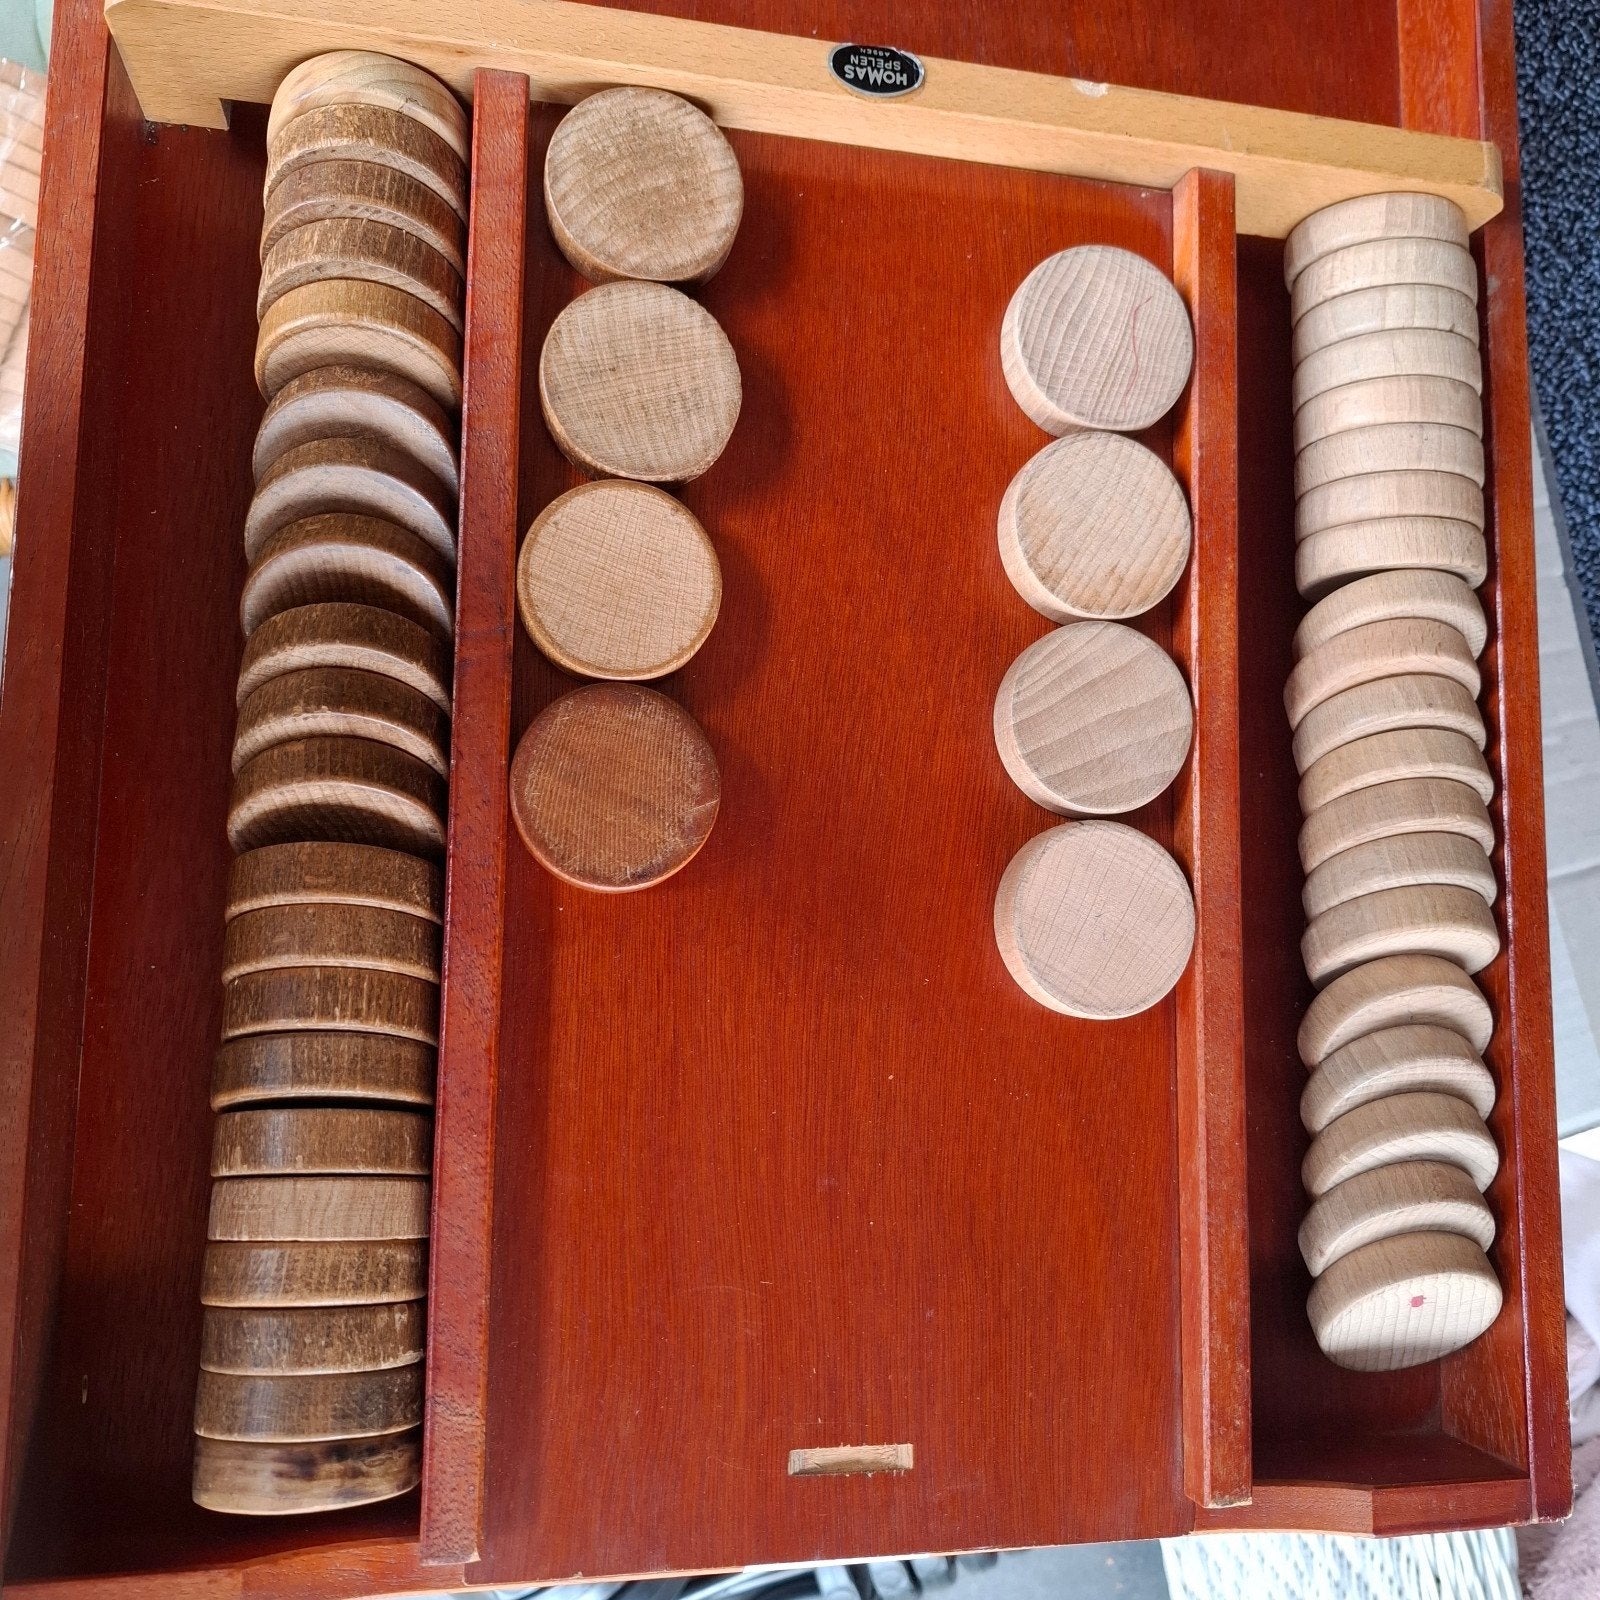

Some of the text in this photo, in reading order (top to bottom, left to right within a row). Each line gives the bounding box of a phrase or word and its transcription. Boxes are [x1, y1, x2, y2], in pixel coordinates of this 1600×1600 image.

[860, 48, 890, 57] ASSEN
[850, 54, 901, 71] SPELEN
[844, 64, 907, 86] HOMAS
